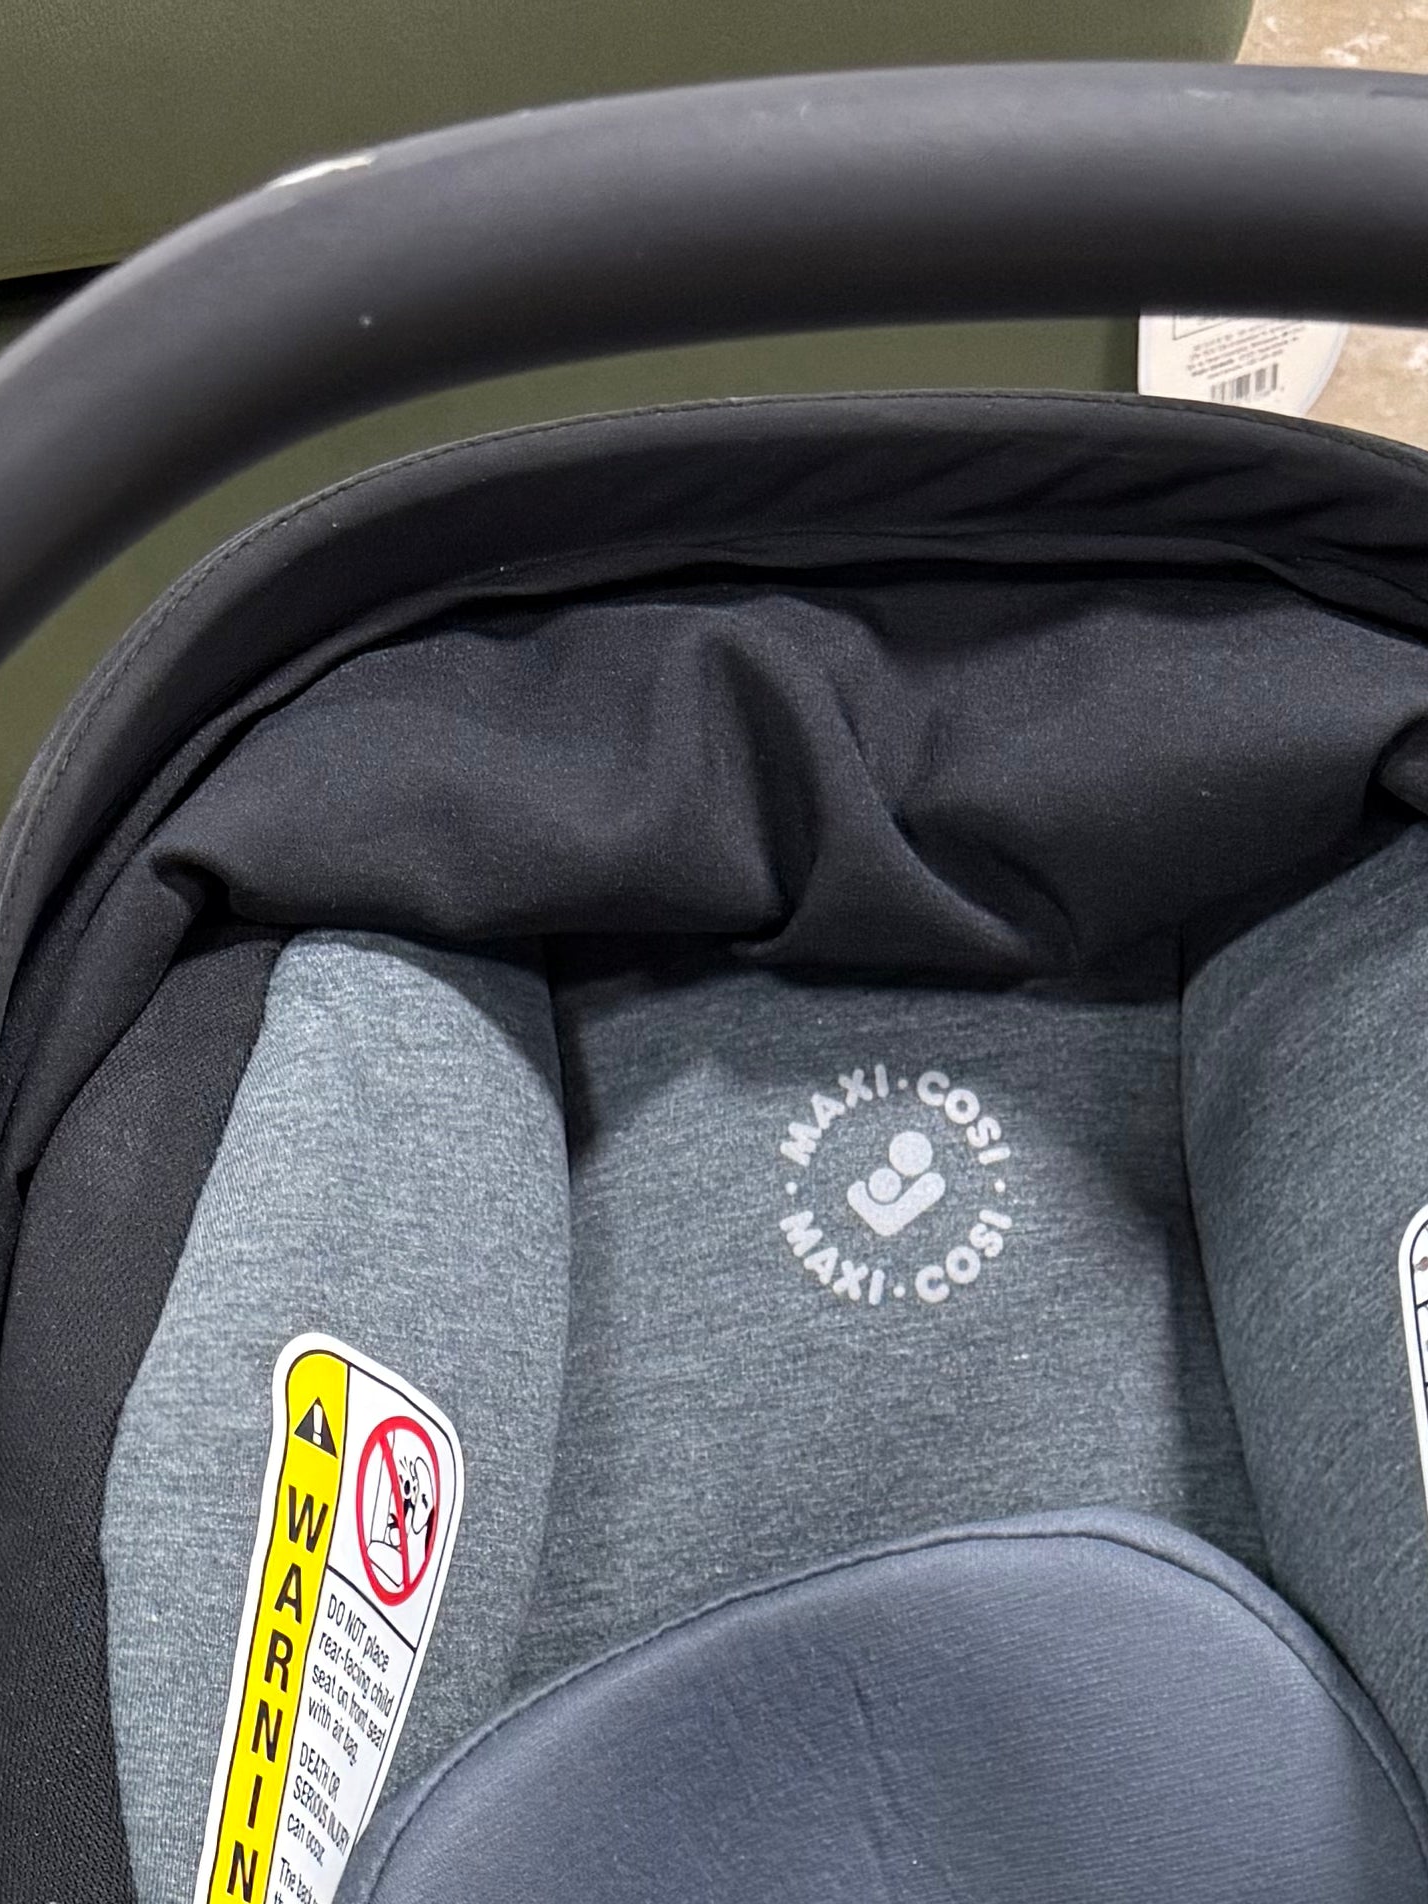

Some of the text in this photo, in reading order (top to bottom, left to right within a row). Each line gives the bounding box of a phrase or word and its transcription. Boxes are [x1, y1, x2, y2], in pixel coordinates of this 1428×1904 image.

[327, 1593, 390, 1673] DO NOT place
[318, 1632, 395, 1718] rear-facing child
[308, 1696, 332, 1732] with
[332, 1717, 345, 1744] air
[312, 1664, 387, 1751] seat on front seat
[299, 1741, 331, 1790] DEATH
[293, 1775, 329, 1829] SERIOUS
[279, 1857, 296, 1892] The
